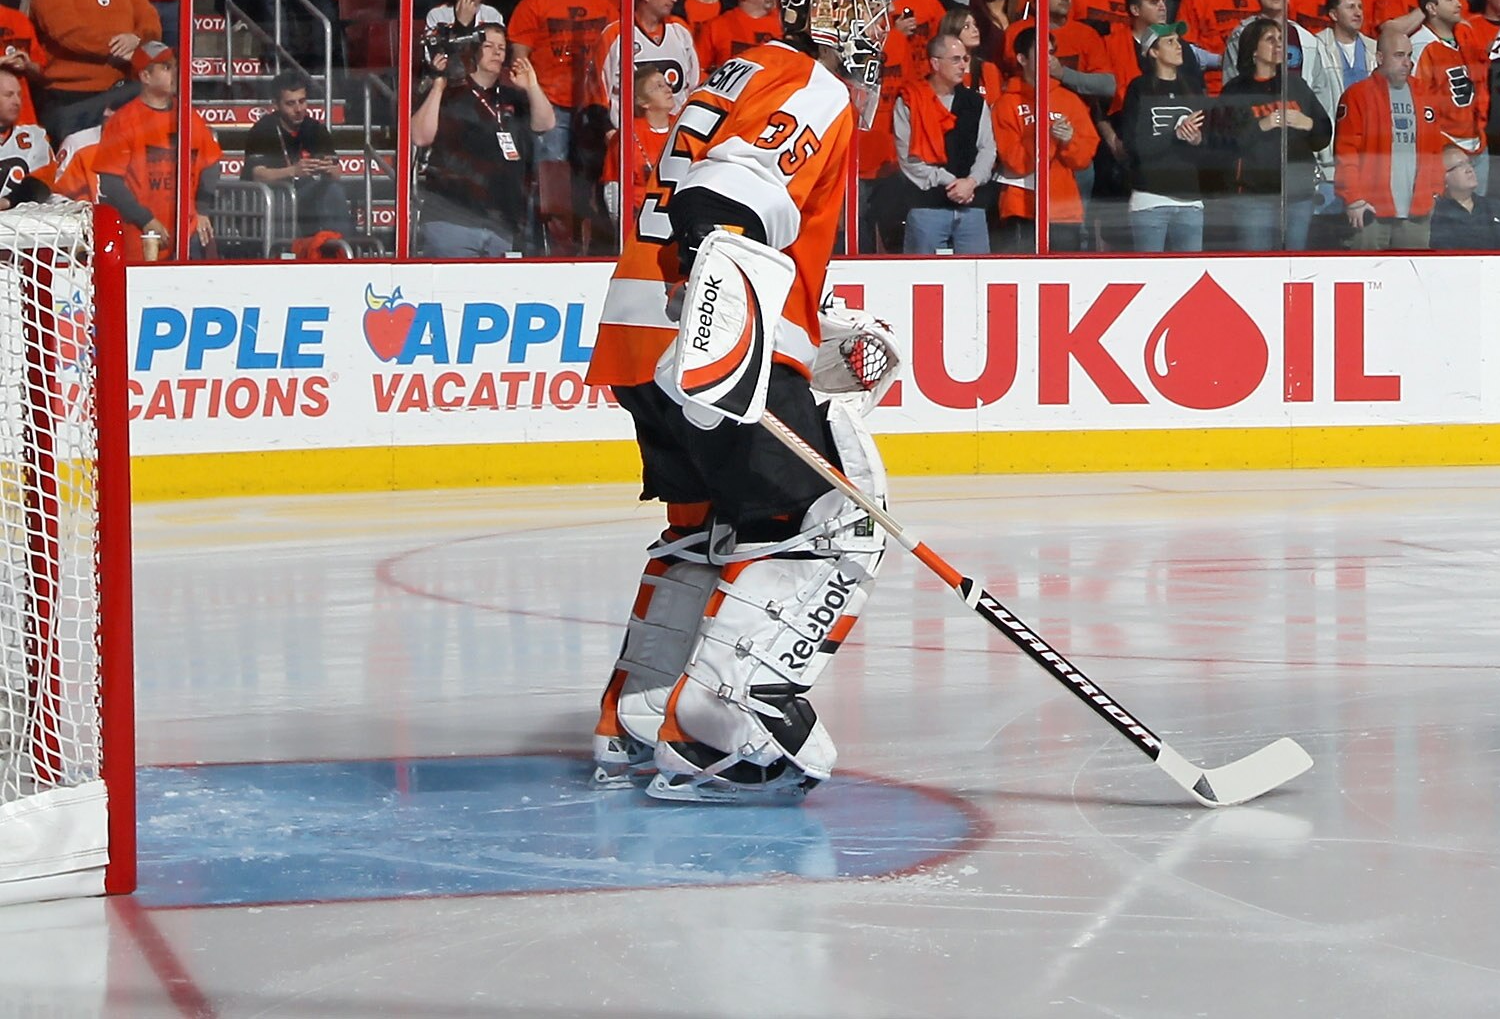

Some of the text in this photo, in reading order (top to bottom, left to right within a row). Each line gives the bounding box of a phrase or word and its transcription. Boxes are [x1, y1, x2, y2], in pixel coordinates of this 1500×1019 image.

[705, 60, 754, 93] SKY
[15, 131, 32, 150] C
[755, 110, 821, 177] 35
[135, 306, 330, 372] PPLE
[395, 302, 595, 364] APPL
[692, 274, 724, 353] Reebok
[127, 374, 329, 421] CATIONS
[778, 568, 858, 672] Reebok
[979, 594, 1163, 751] WARRIOR
